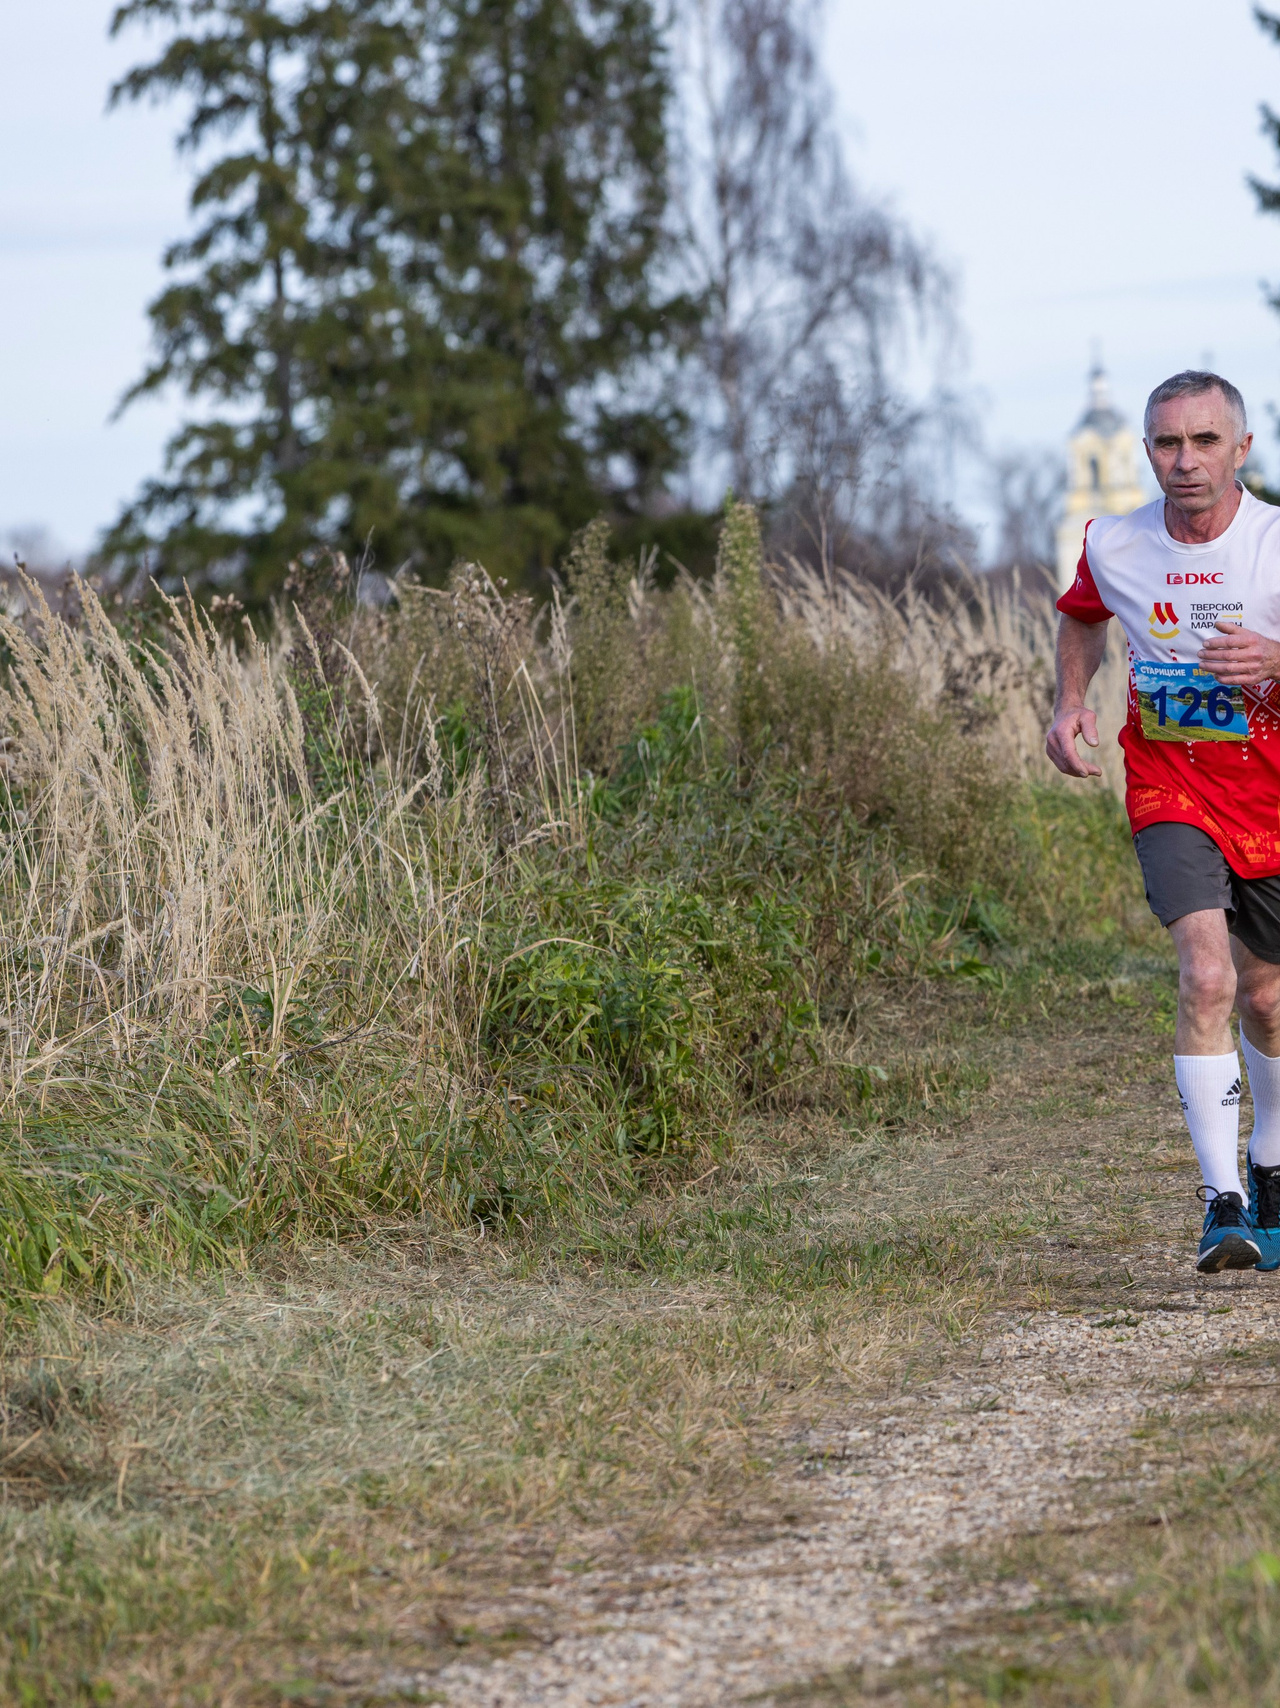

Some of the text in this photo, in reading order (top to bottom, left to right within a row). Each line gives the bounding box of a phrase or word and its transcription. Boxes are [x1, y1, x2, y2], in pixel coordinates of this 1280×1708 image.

[1185, 572, 1224, 584] DKC
[1190, 602, 1243, 611] ТВЕРСКОЙ
[1190, 612, 1219, 620] ПОЛУ
[1191, 621, 1243, 629] МАРН
[1140, 665, 1187, 677] СТАРИЦКИЕ
[1150, 685, 1235, 728] 126
